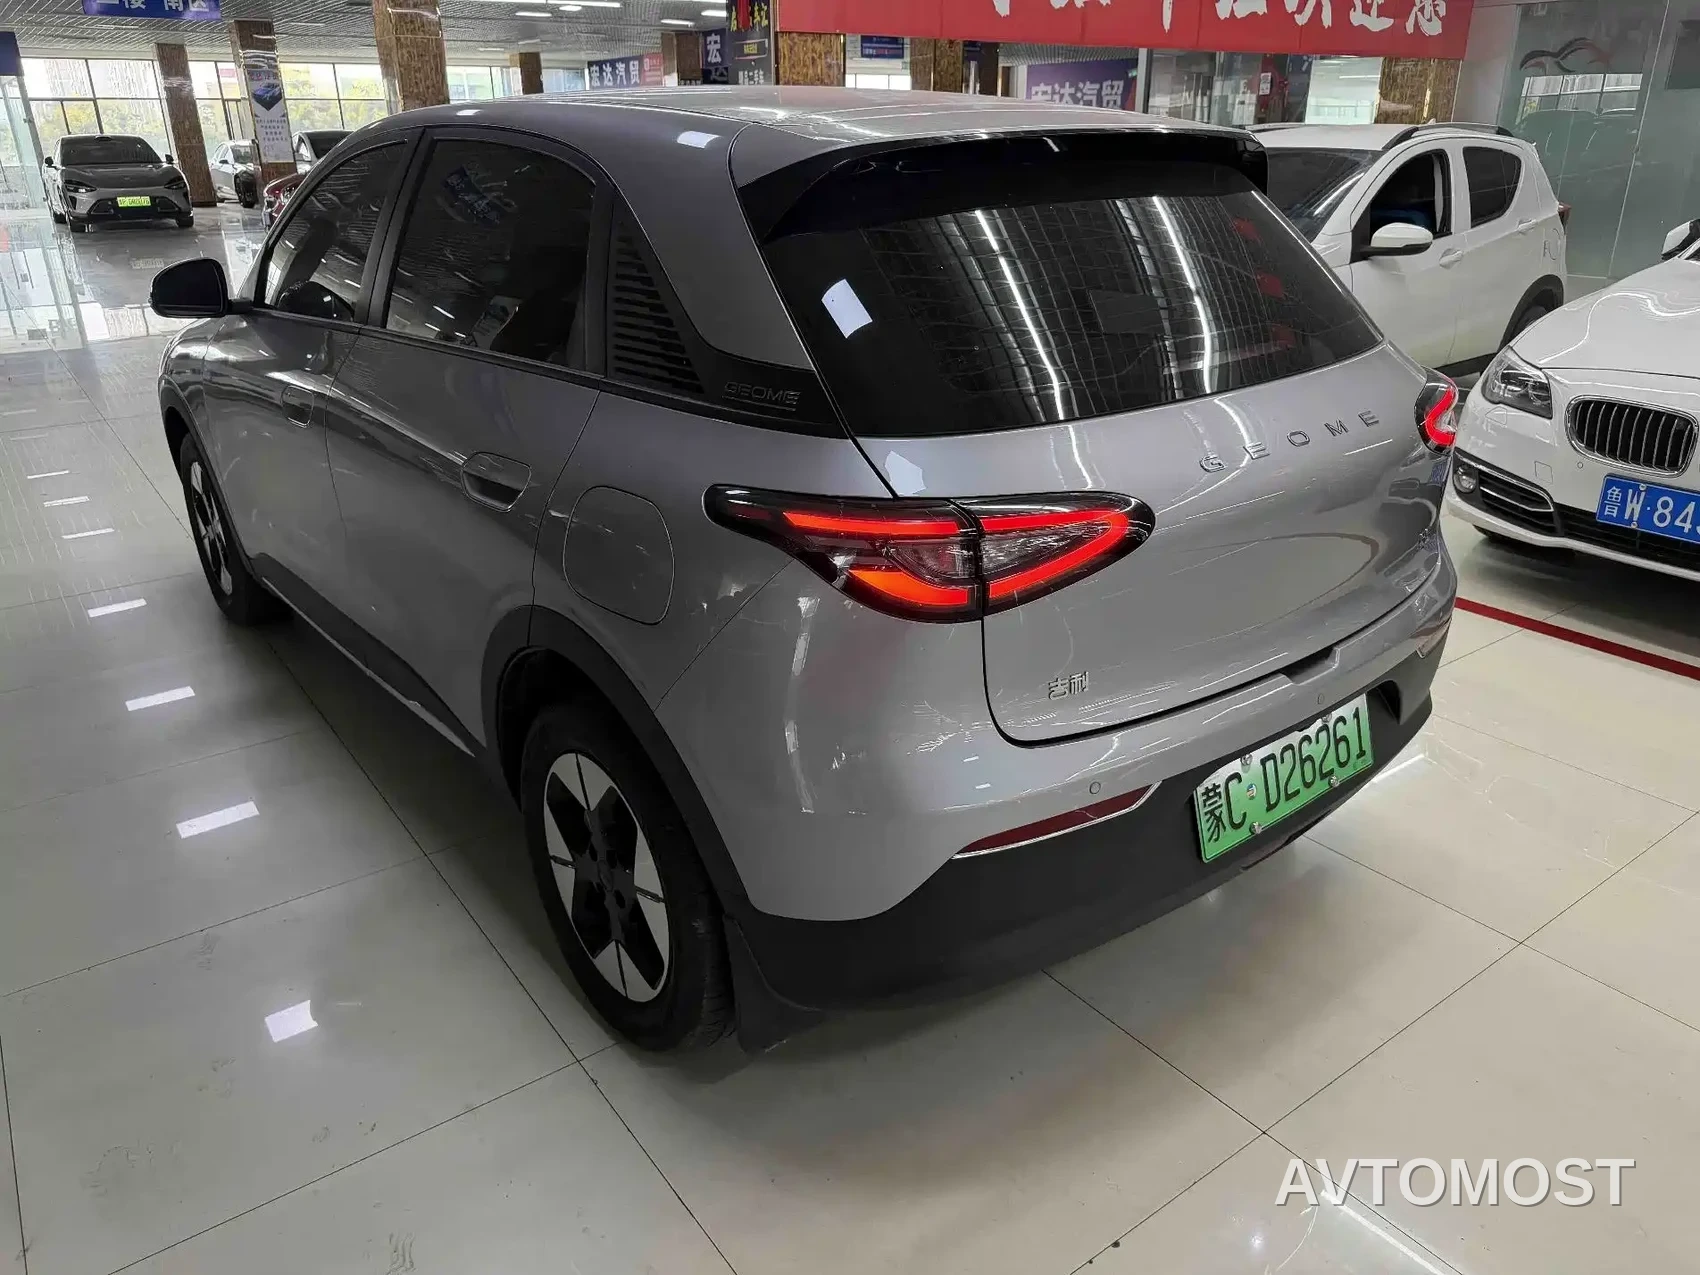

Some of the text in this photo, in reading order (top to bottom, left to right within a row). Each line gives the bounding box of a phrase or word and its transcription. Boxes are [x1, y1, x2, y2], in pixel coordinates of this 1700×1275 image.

[589, 59, 640, 87] 宏达汽贸
[724, 381, 802, 405] GEOME
[1199, 408, 1380, 473] GEOME
[1603, 485, 1700, 536] 鲁W·84
[1048, 671, 1089, 701] 吉利
